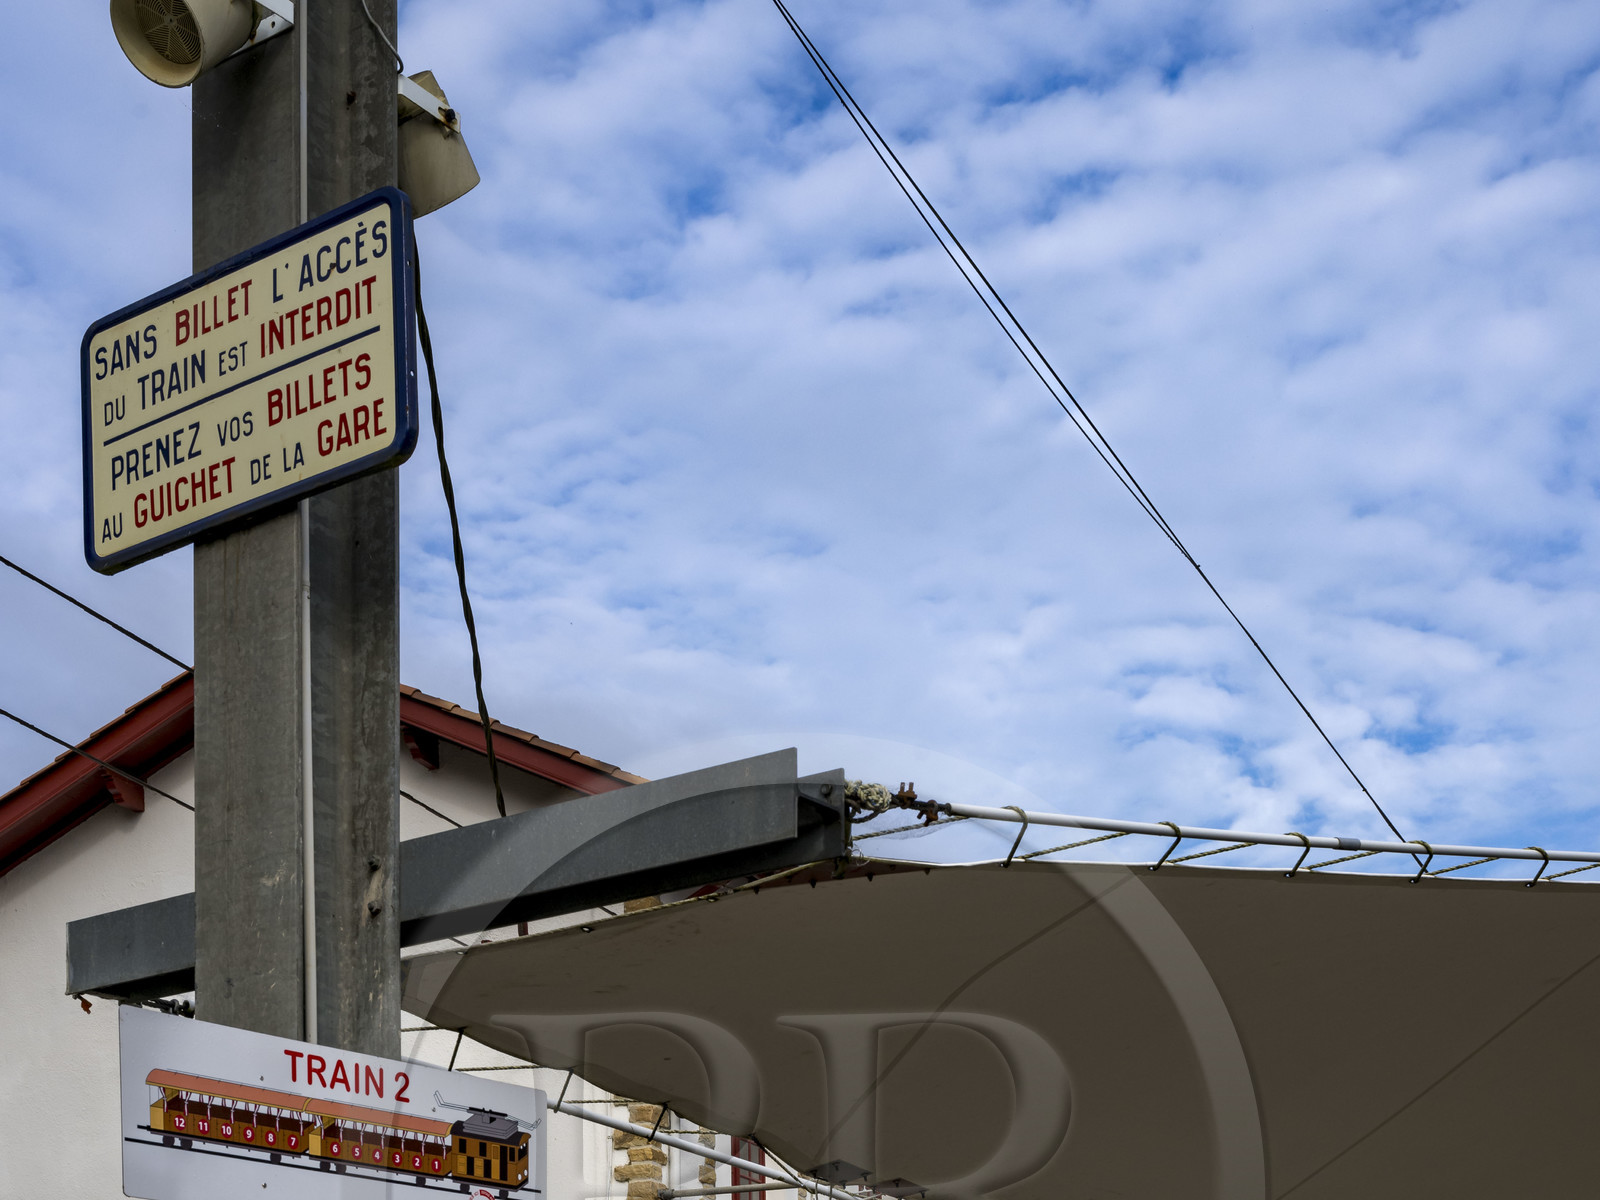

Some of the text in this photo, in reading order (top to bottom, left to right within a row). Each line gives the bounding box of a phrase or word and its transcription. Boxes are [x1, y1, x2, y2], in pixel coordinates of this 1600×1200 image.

[95, 324, 157, 380] SANS
[176, 279, 252, 347] BILLET
[104, 275, 377, 427] DU TRAIN EST INTERDIT
[102, 397, 387, 543] AU GUICHET DE LA GARE
[111, 353, 372, 491] PRENEZ VOS BILLETS
[284, 1049, 410, 1103] TRAIN 2
[174, 1117, 439, 1170] 12 11 10 9 8 7 6 5 4 3 2 1
